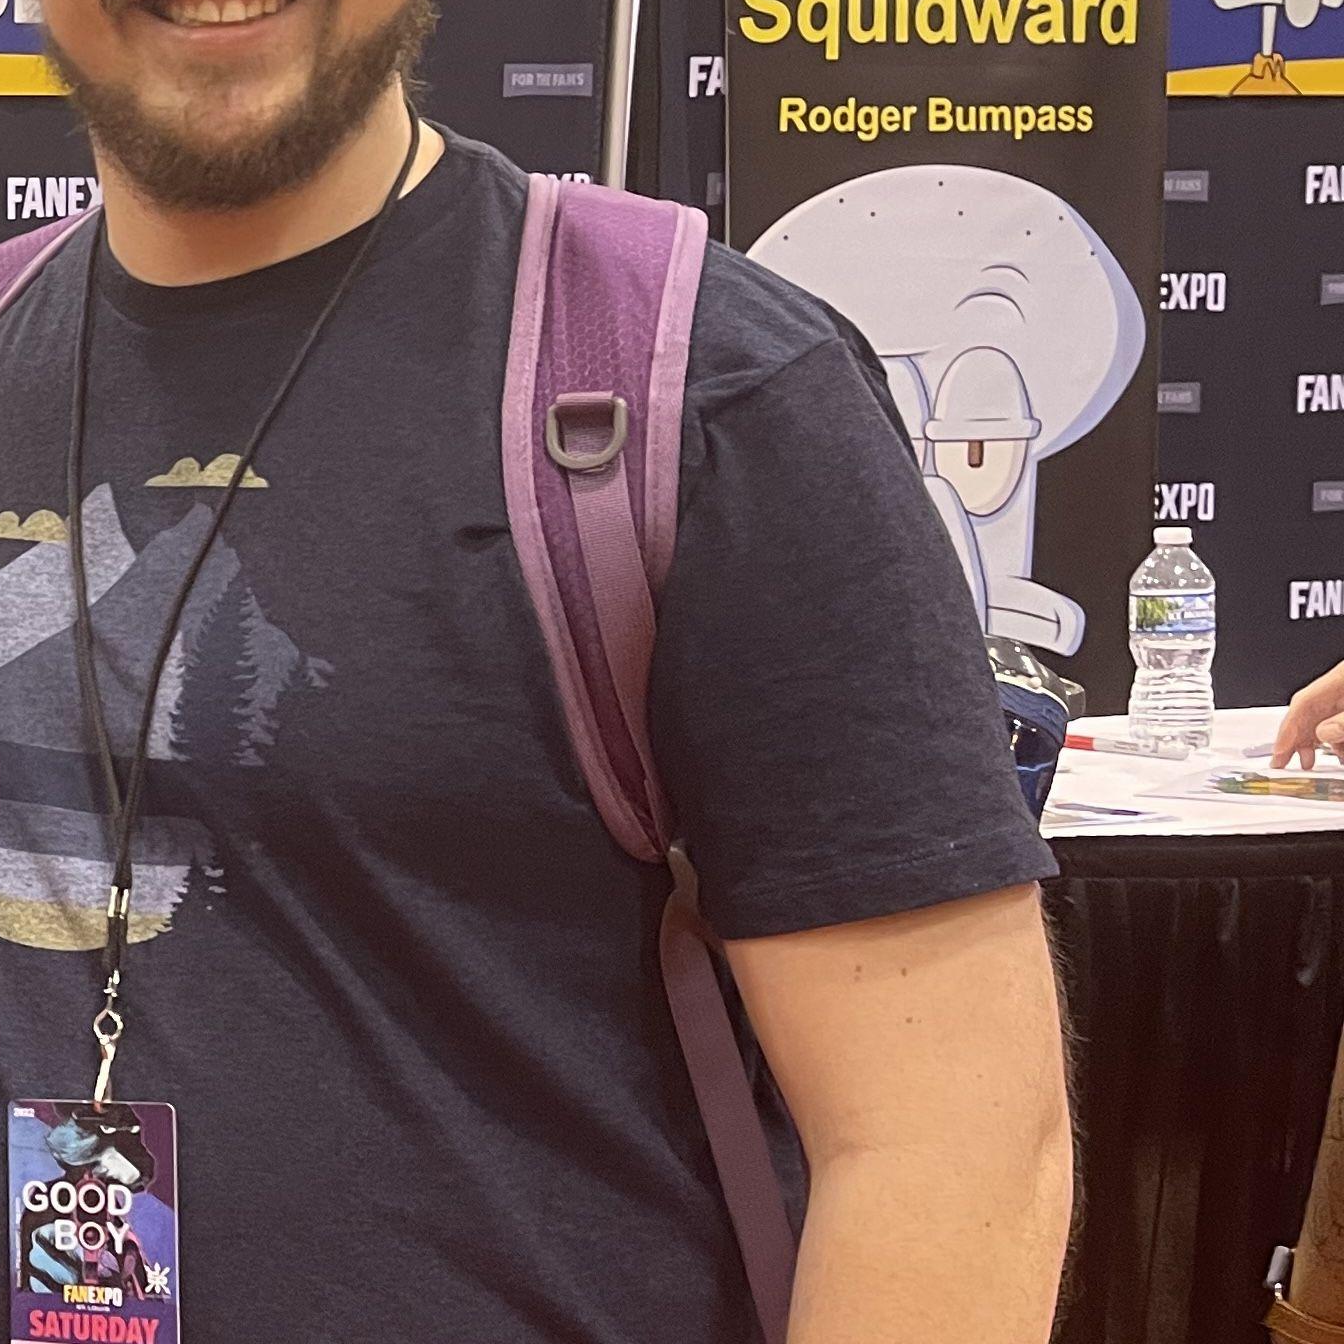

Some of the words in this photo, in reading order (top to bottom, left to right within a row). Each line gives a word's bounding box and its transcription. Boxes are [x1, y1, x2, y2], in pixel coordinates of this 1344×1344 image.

[779, 97, 917, 141] Rodger
[927, 98, 1094, 139] Bumpass
[23, 1181, 133, 1215] GOOD
[55, 1219, 129, 1255] BOY
[63, 1284, 123, 1307] FANEXPO
